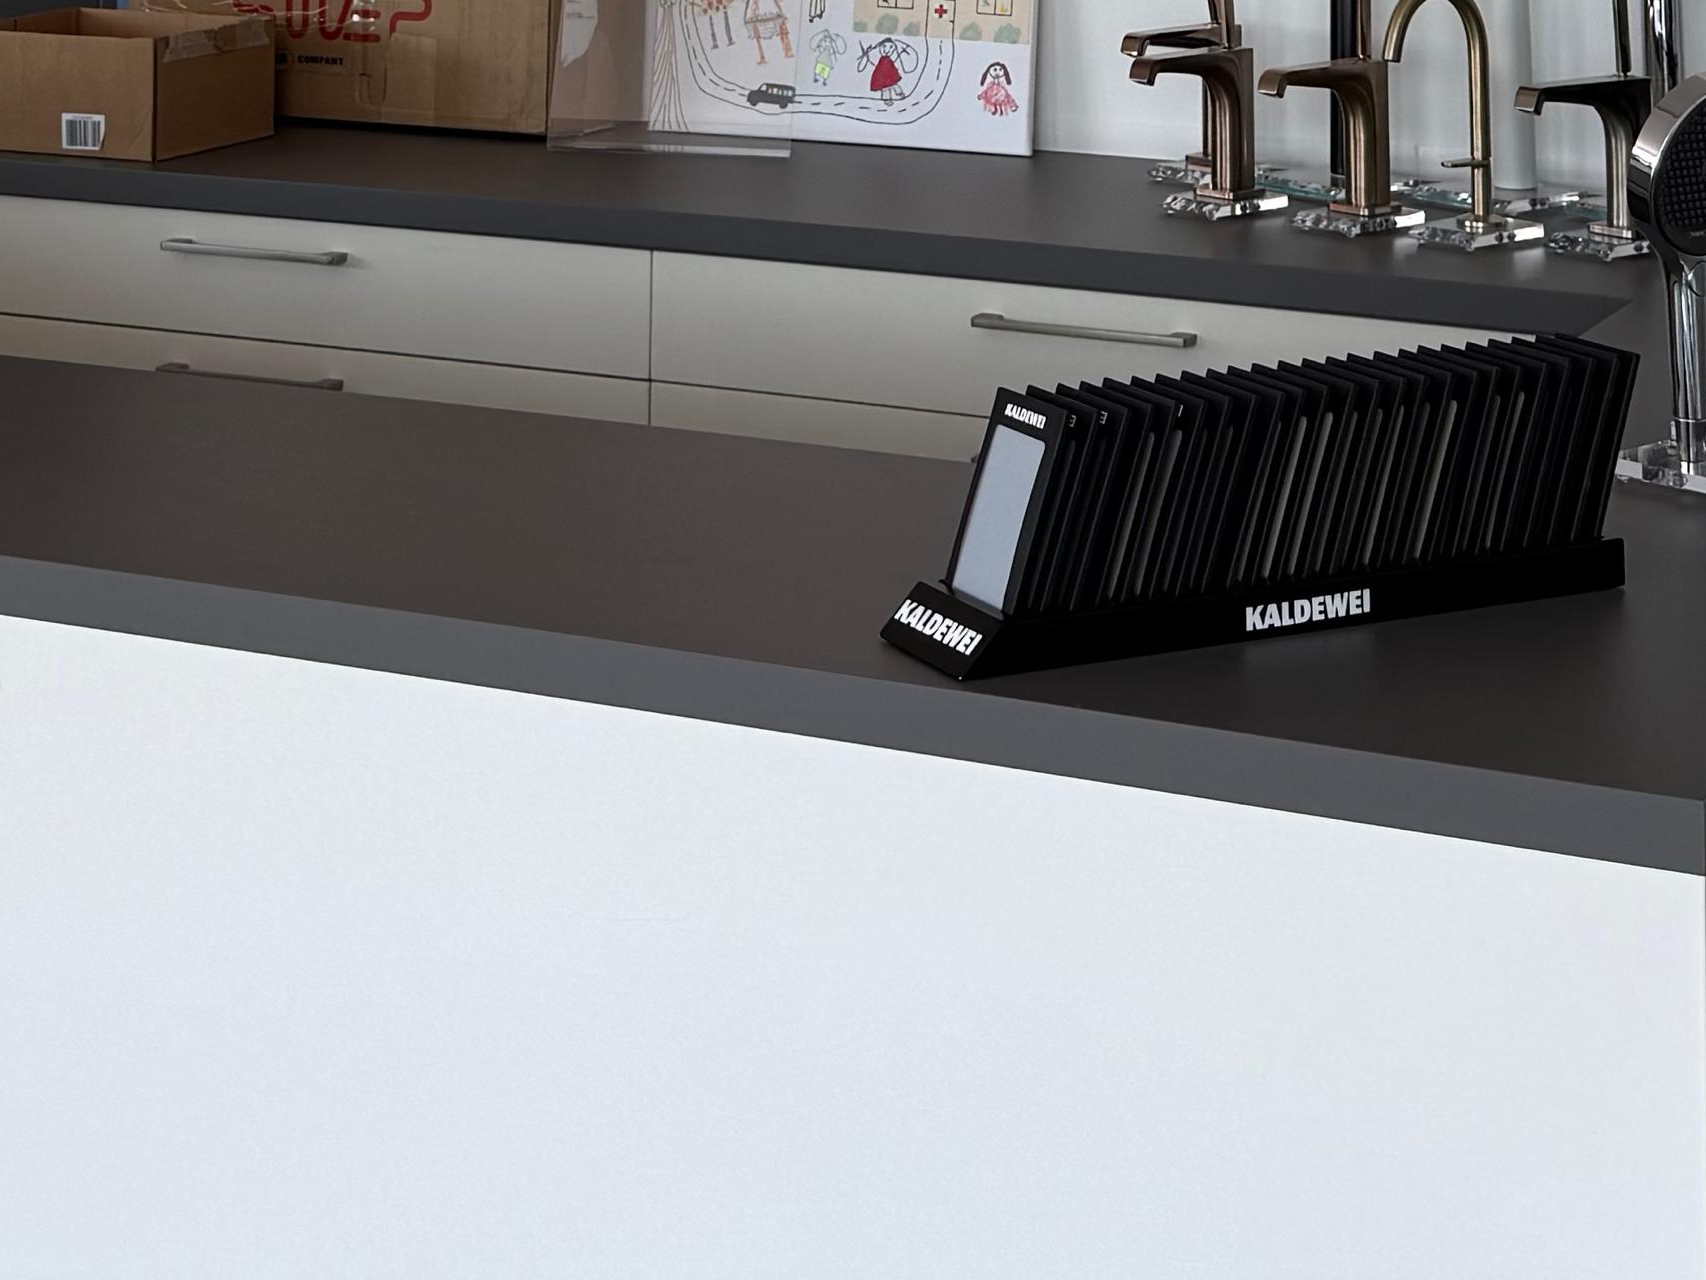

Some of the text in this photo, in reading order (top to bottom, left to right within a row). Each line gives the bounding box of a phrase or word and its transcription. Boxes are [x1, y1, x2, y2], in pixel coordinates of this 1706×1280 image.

[1004, 403, 1047, 429] KALDEWEI
[894, 599, 983, 656] KALDEWEI
[1246, 588, 1371, 632] KALDEWEI
